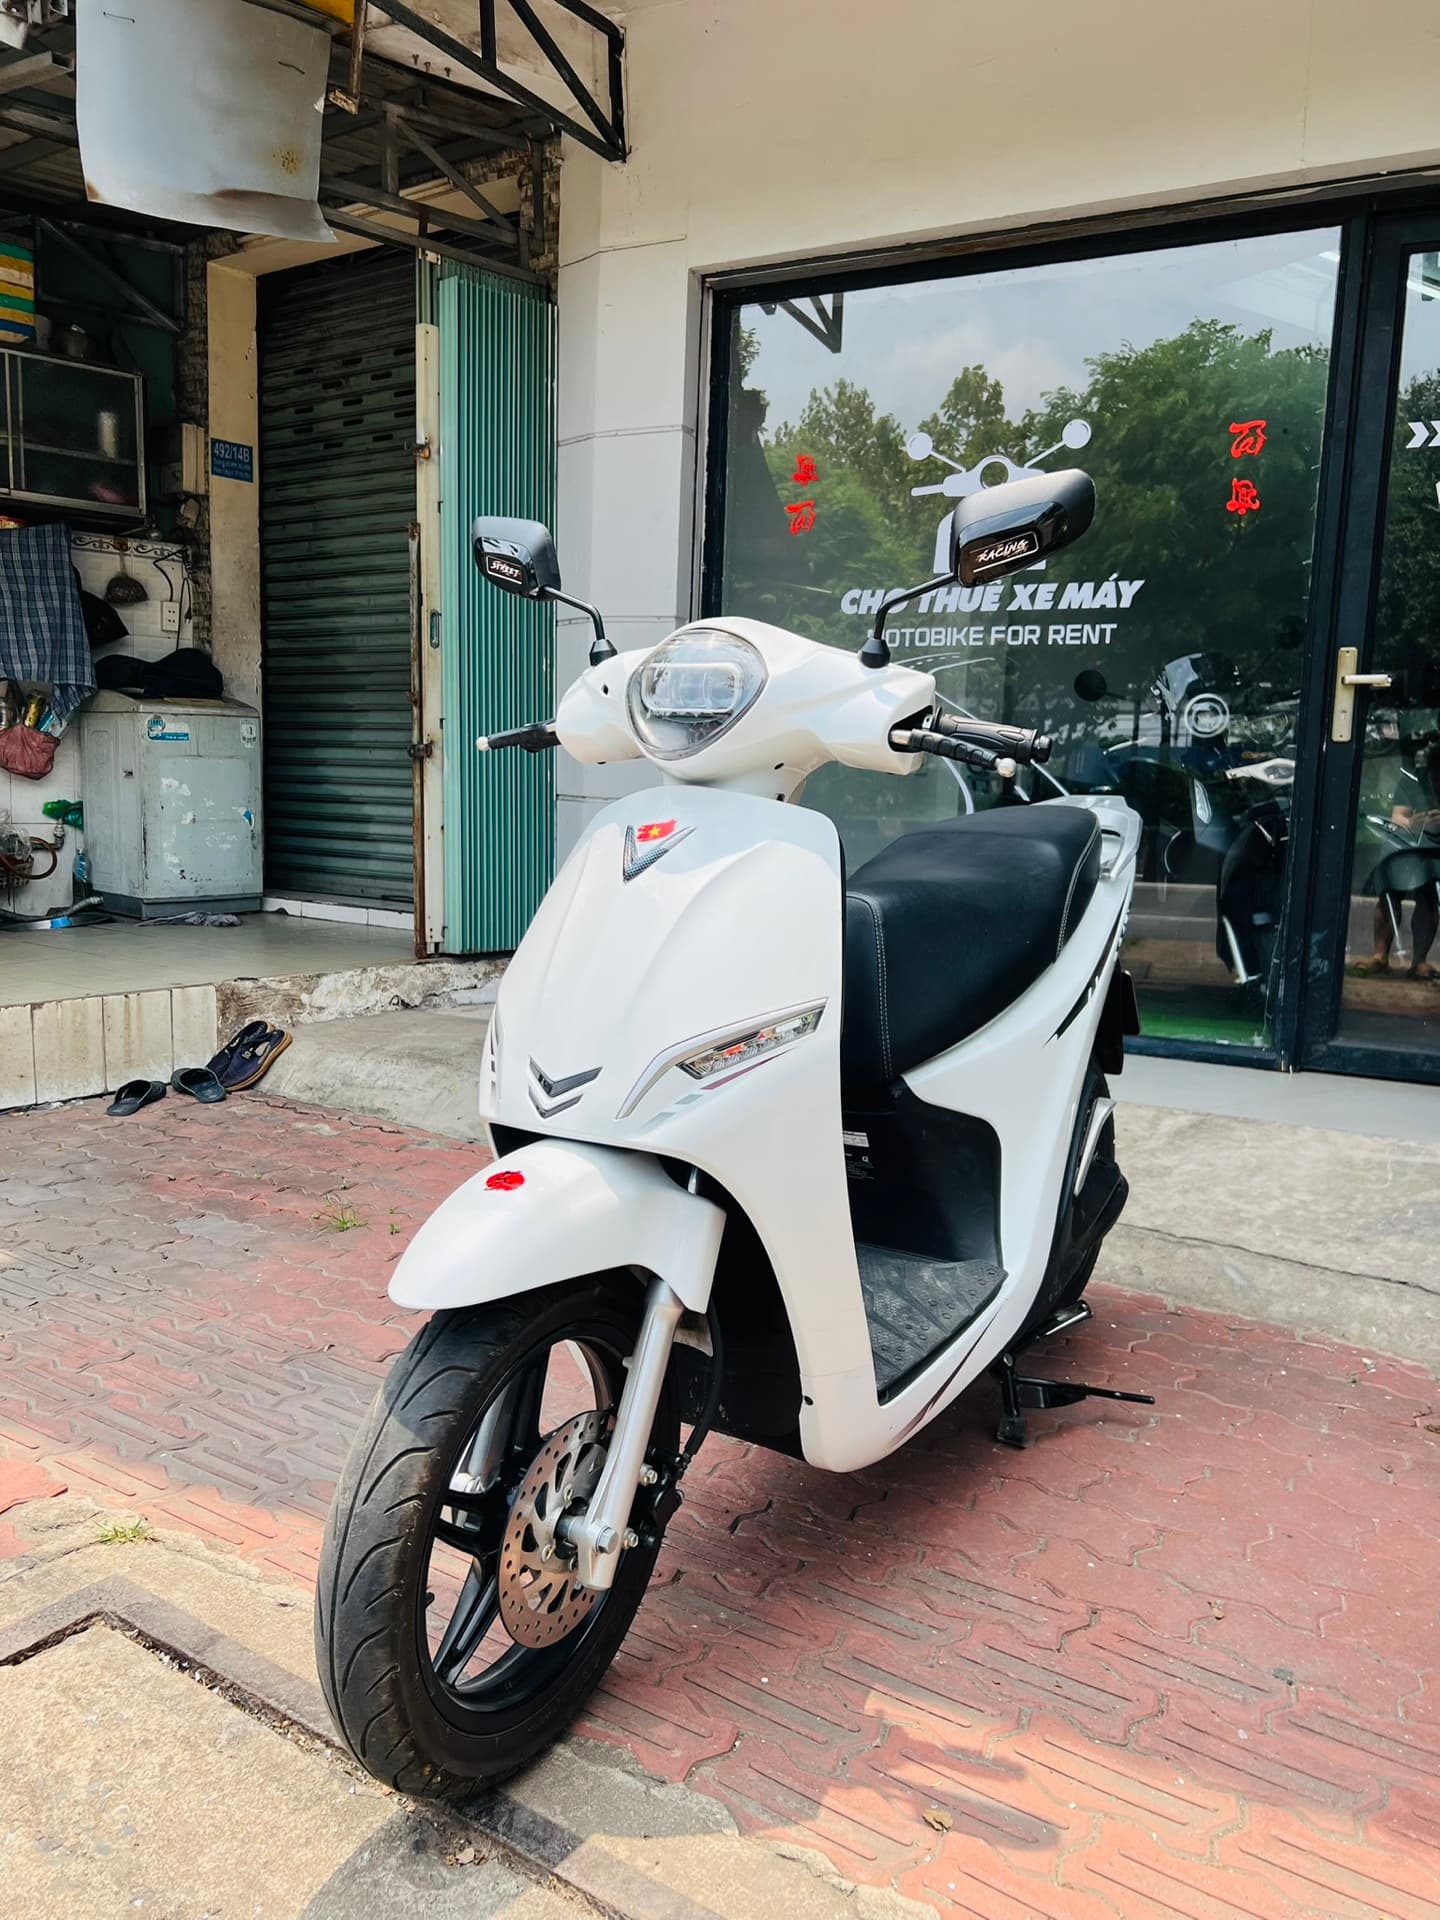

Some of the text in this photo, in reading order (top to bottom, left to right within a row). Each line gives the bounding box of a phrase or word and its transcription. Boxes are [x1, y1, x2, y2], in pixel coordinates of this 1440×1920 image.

[213, 441, 251, 463] 492/14B
[976, 539, 1030, 563] RACING
[1006, 583, 1059, 611] XE
[1057, 572, 1146, 610] MÁY
[990, 625, 1042, 646] FOR
[1047, 623, 1118, 645] RENT
